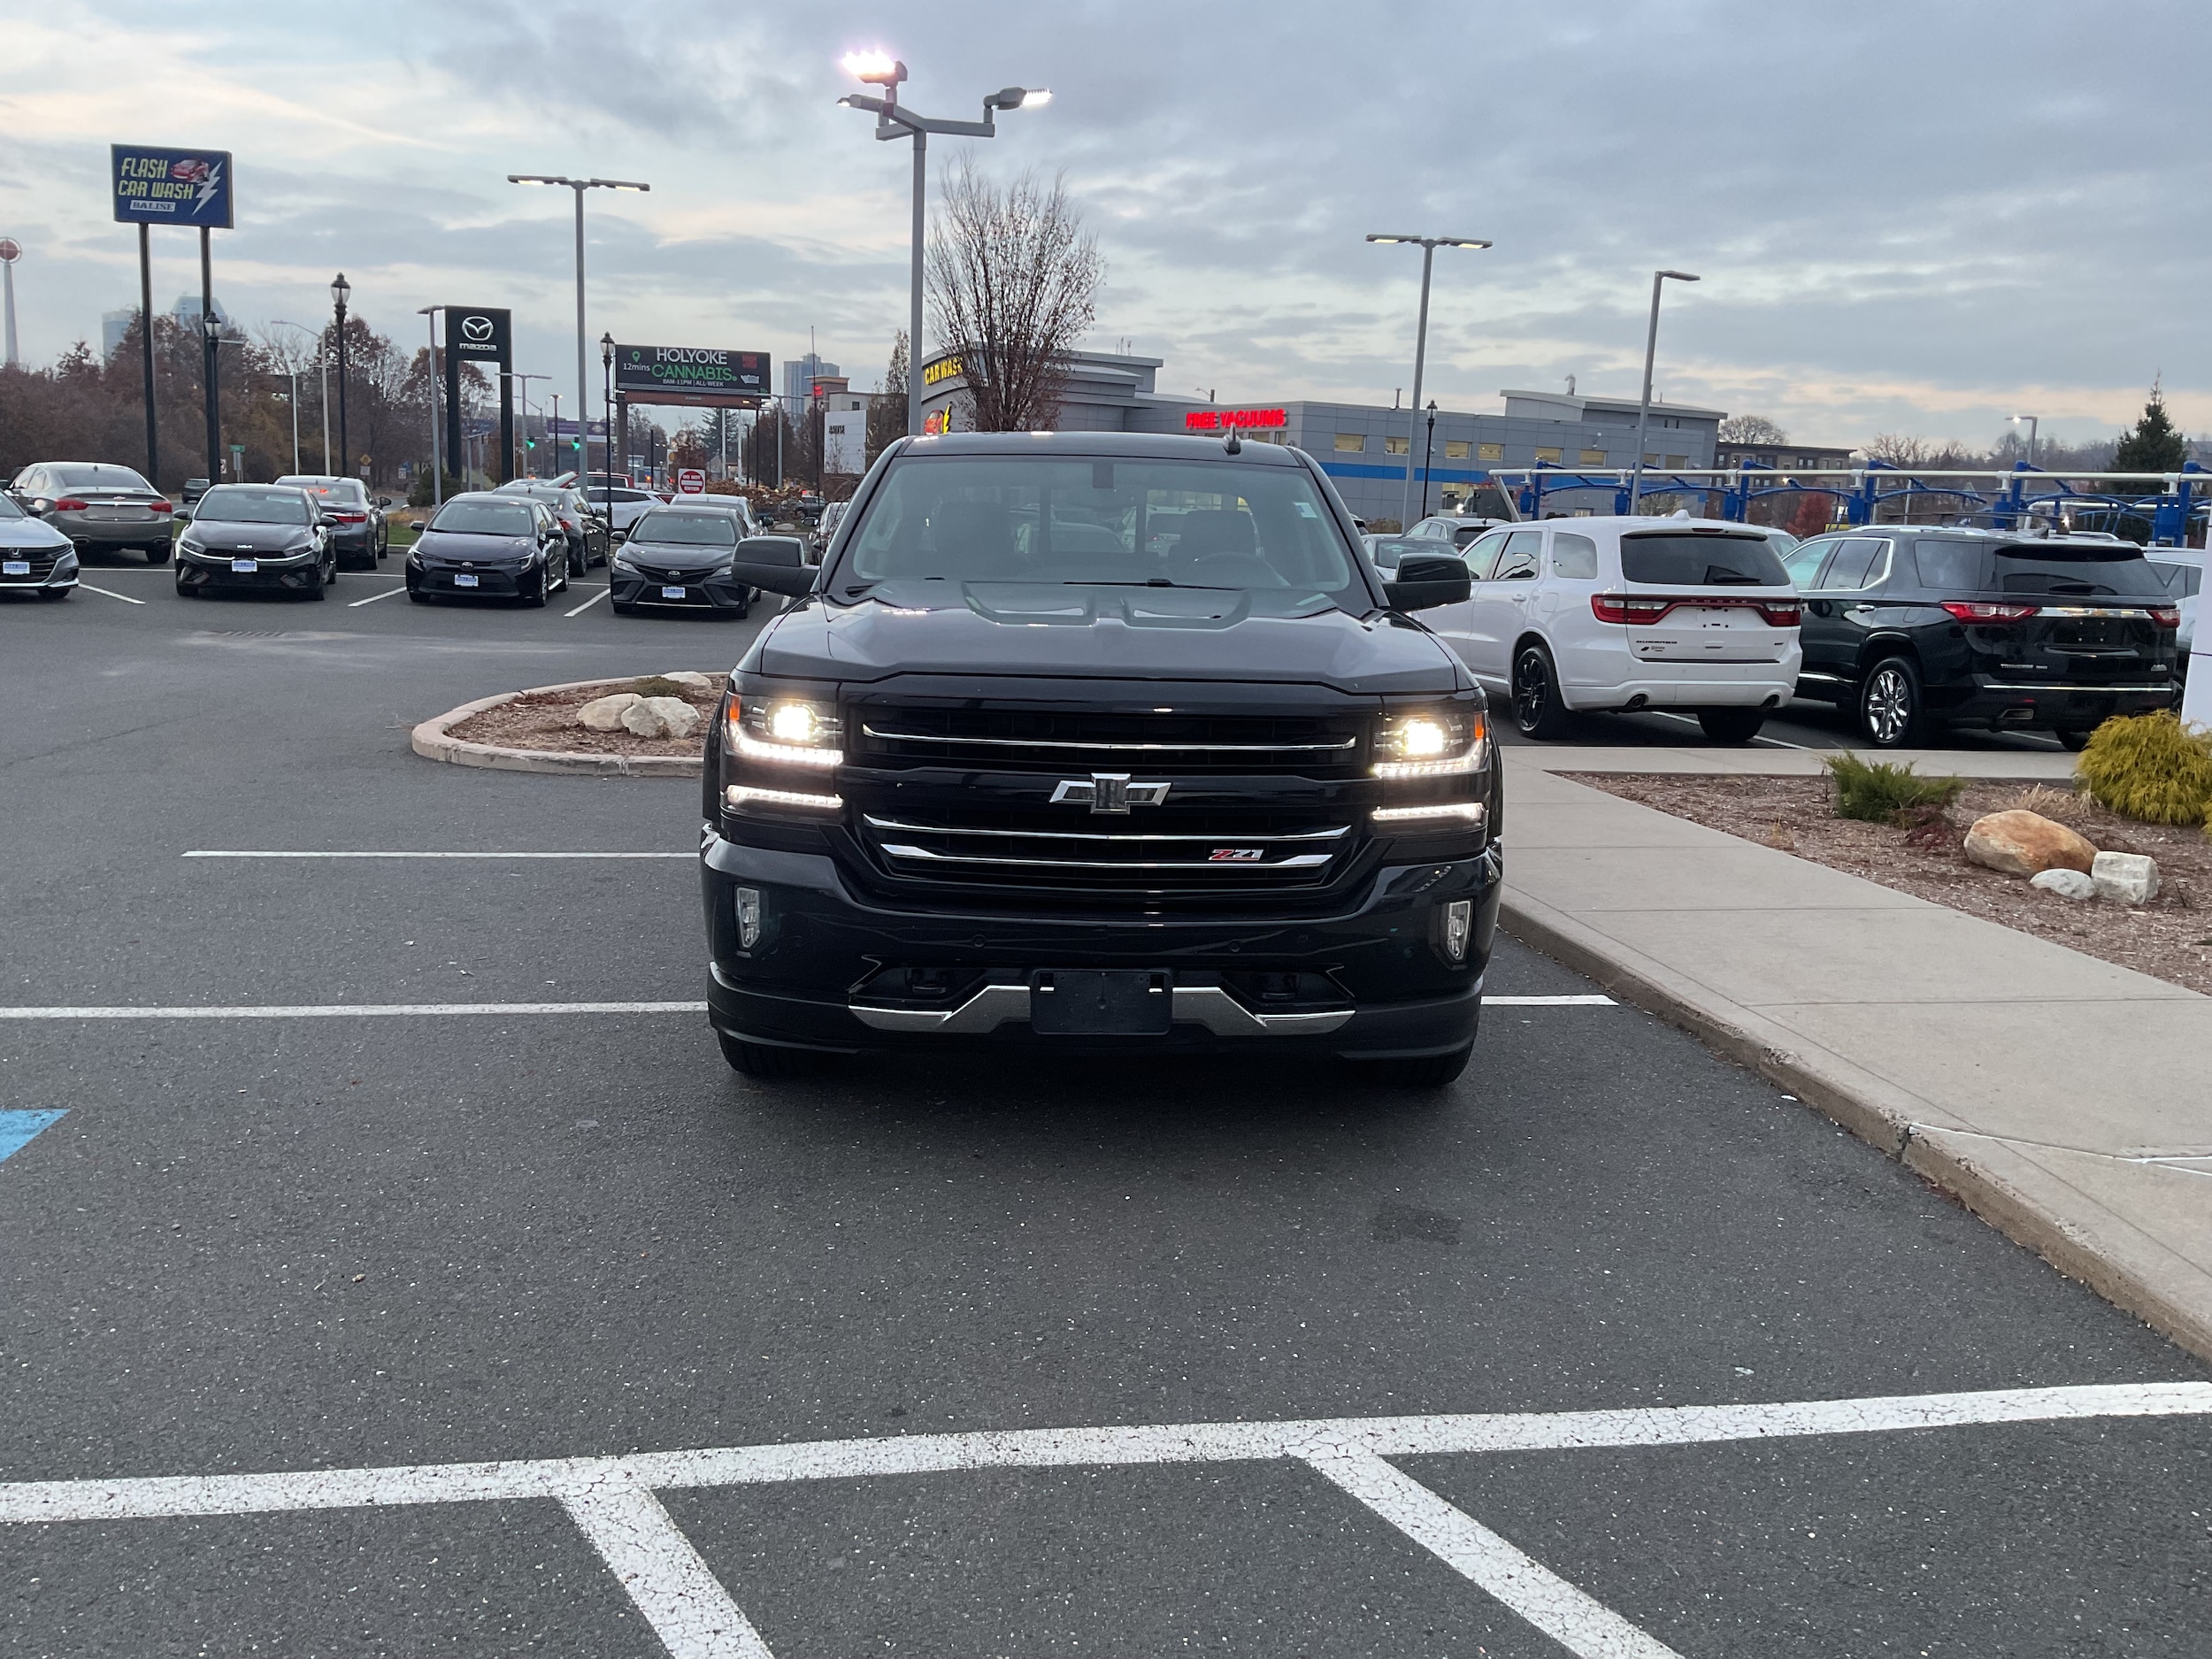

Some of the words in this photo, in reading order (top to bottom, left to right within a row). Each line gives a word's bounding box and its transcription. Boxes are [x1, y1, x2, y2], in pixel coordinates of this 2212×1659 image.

[121, 157, 168, 179] FLASH
[118, 180, 148, 197] CAR
[151, 182, 194, 200] WASH
[133, 201, 174, 211] BALISE
[656, 348, 728, 365] HOLYOKE
[623, 363, 650, 372] 12mins
[925, 364, 940, 385] CAR
[1186, 411, 1217, 429] FREE
[1220, 408, 1286, 428] VACUUMS
